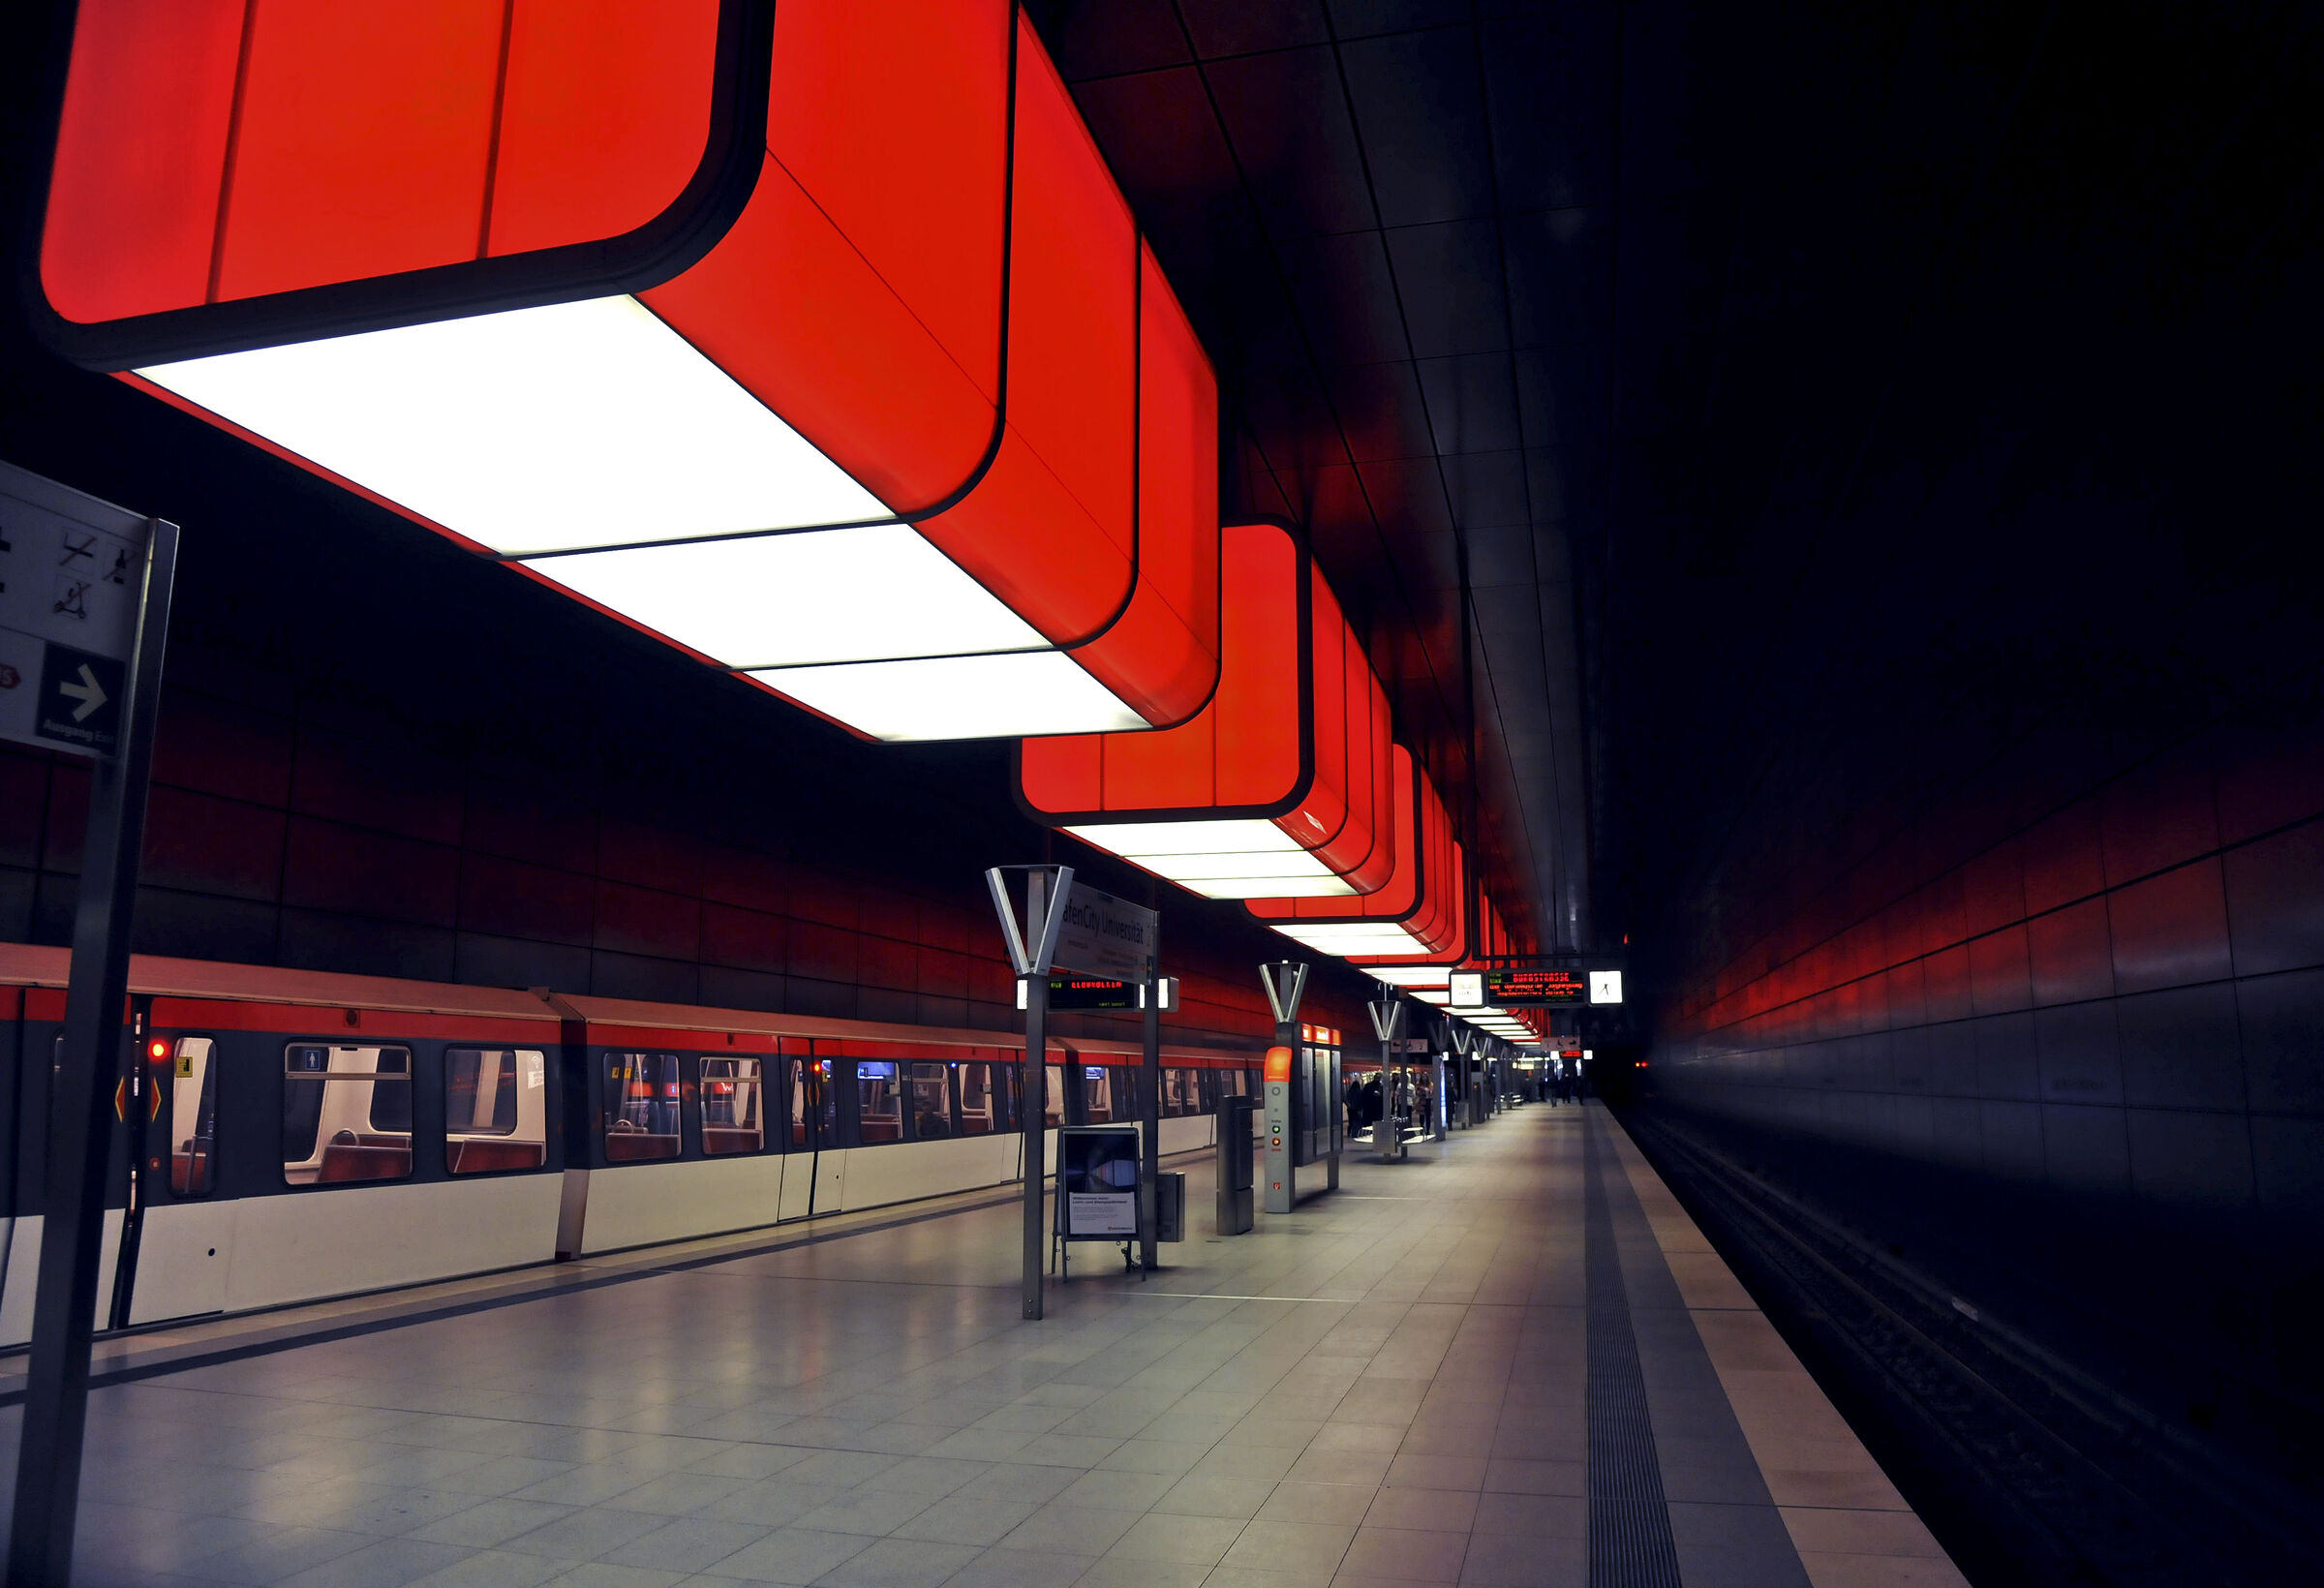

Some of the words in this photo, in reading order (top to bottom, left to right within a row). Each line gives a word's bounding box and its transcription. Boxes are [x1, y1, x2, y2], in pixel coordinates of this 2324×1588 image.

[44, 718, 94, 742] Ausgang
[1063, 899, 1101, 937] afenCity
[1102, 910, 1144, 944] Universität
